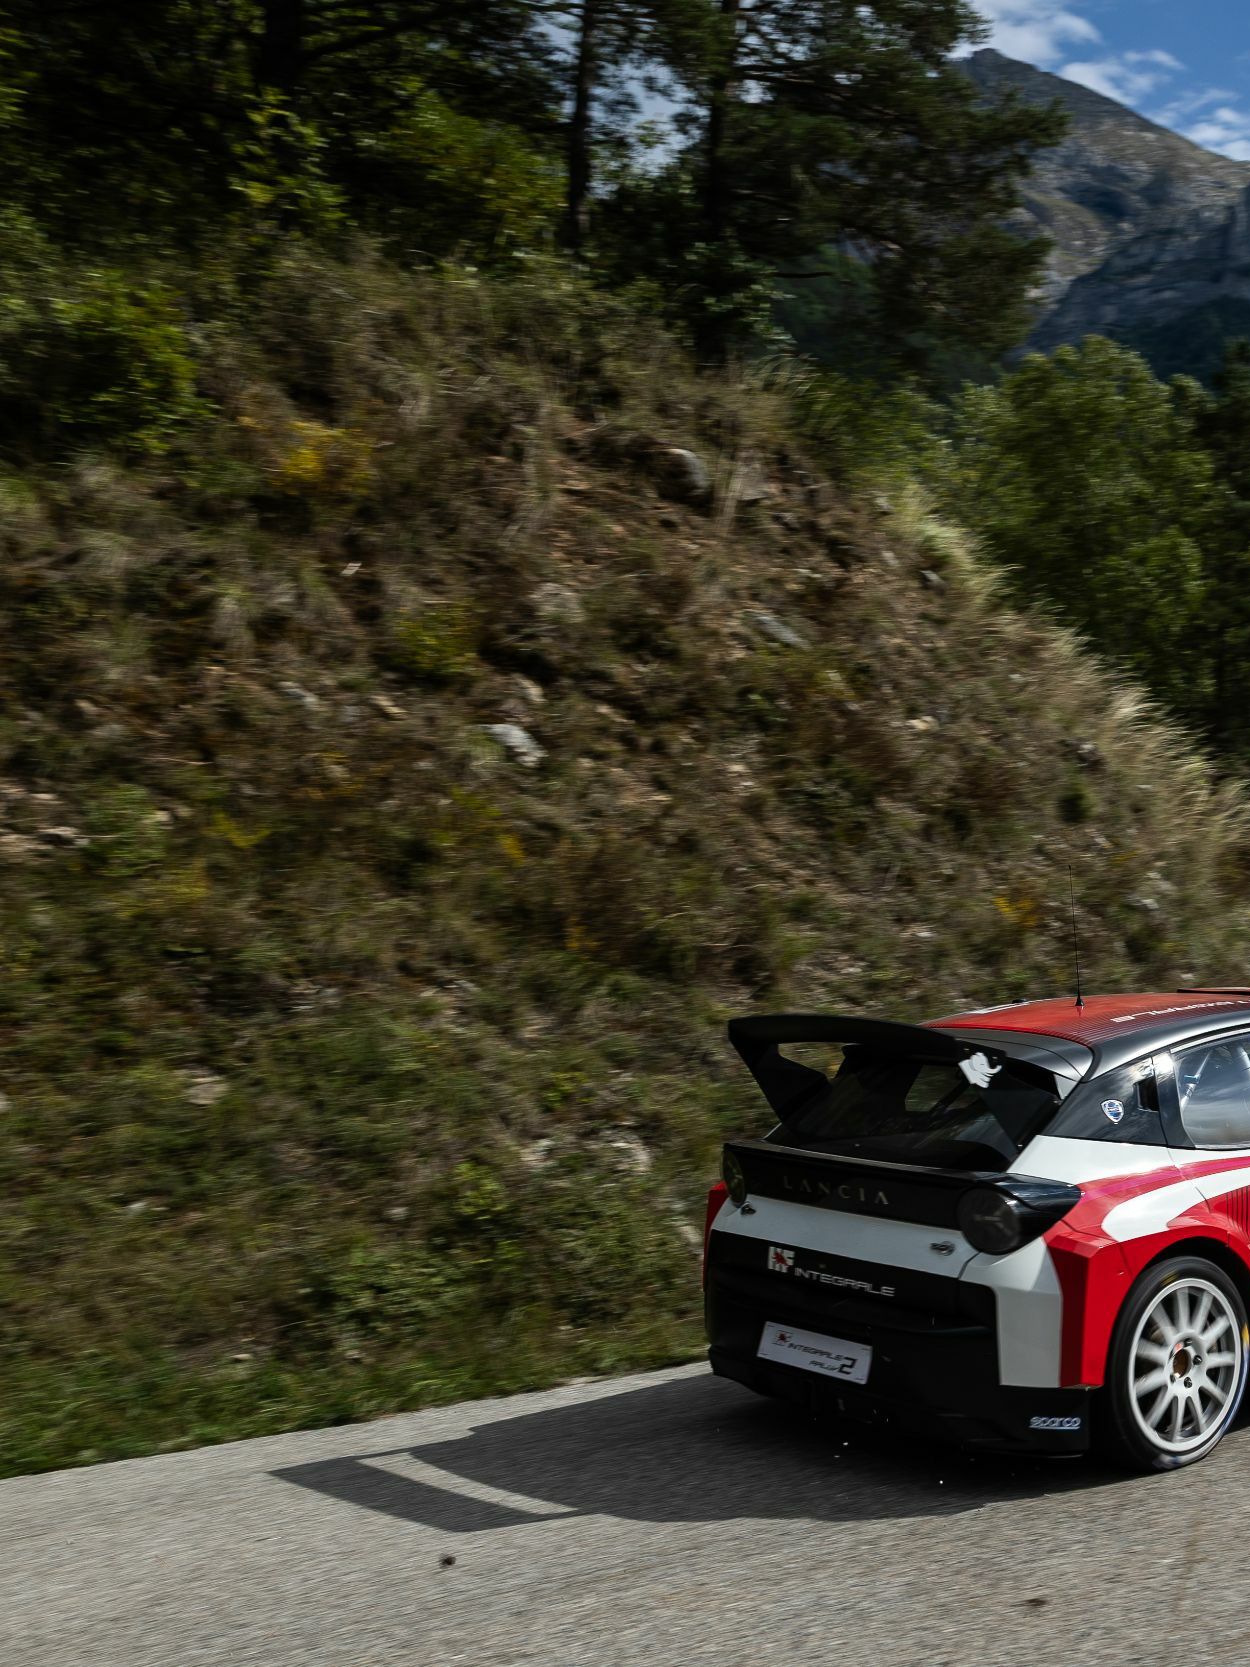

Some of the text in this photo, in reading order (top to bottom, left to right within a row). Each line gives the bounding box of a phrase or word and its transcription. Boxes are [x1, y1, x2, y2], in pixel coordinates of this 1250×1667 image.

[783, 1175, 889, 1205] LANCIA
[794, 1267, 896, 1297] INTEGRALE
[787, 1342, 844, 1362] INTEGRALE
[838, 1356, 859, 1376] 2
[1030, 1416, 1081, 1429] sparco
